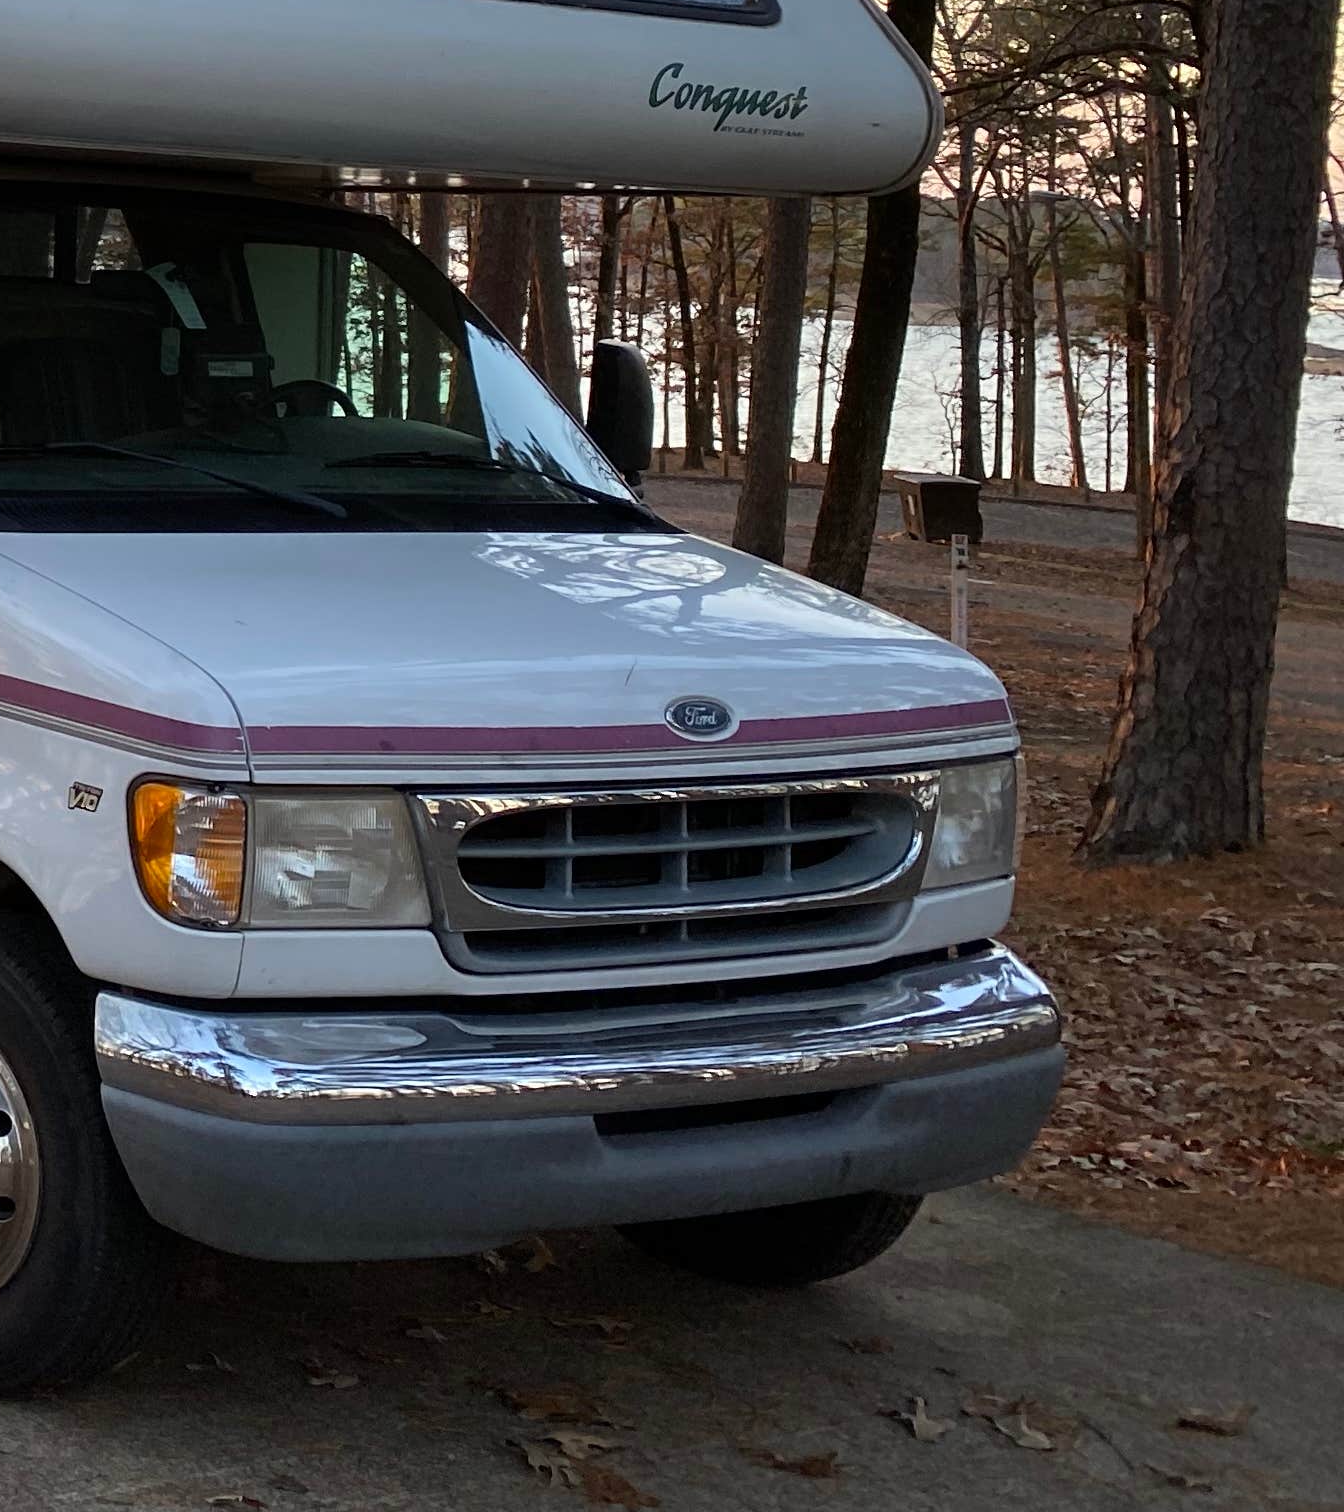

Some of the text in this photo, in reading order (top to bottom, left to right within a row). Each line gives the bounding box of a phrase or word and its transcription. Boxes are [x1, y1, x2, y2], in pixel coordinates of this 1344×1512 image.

[648, 62, 809, 131] Conquest
[685, 706, 718, 726] Ford
[69, 788, 99, 811] V10
